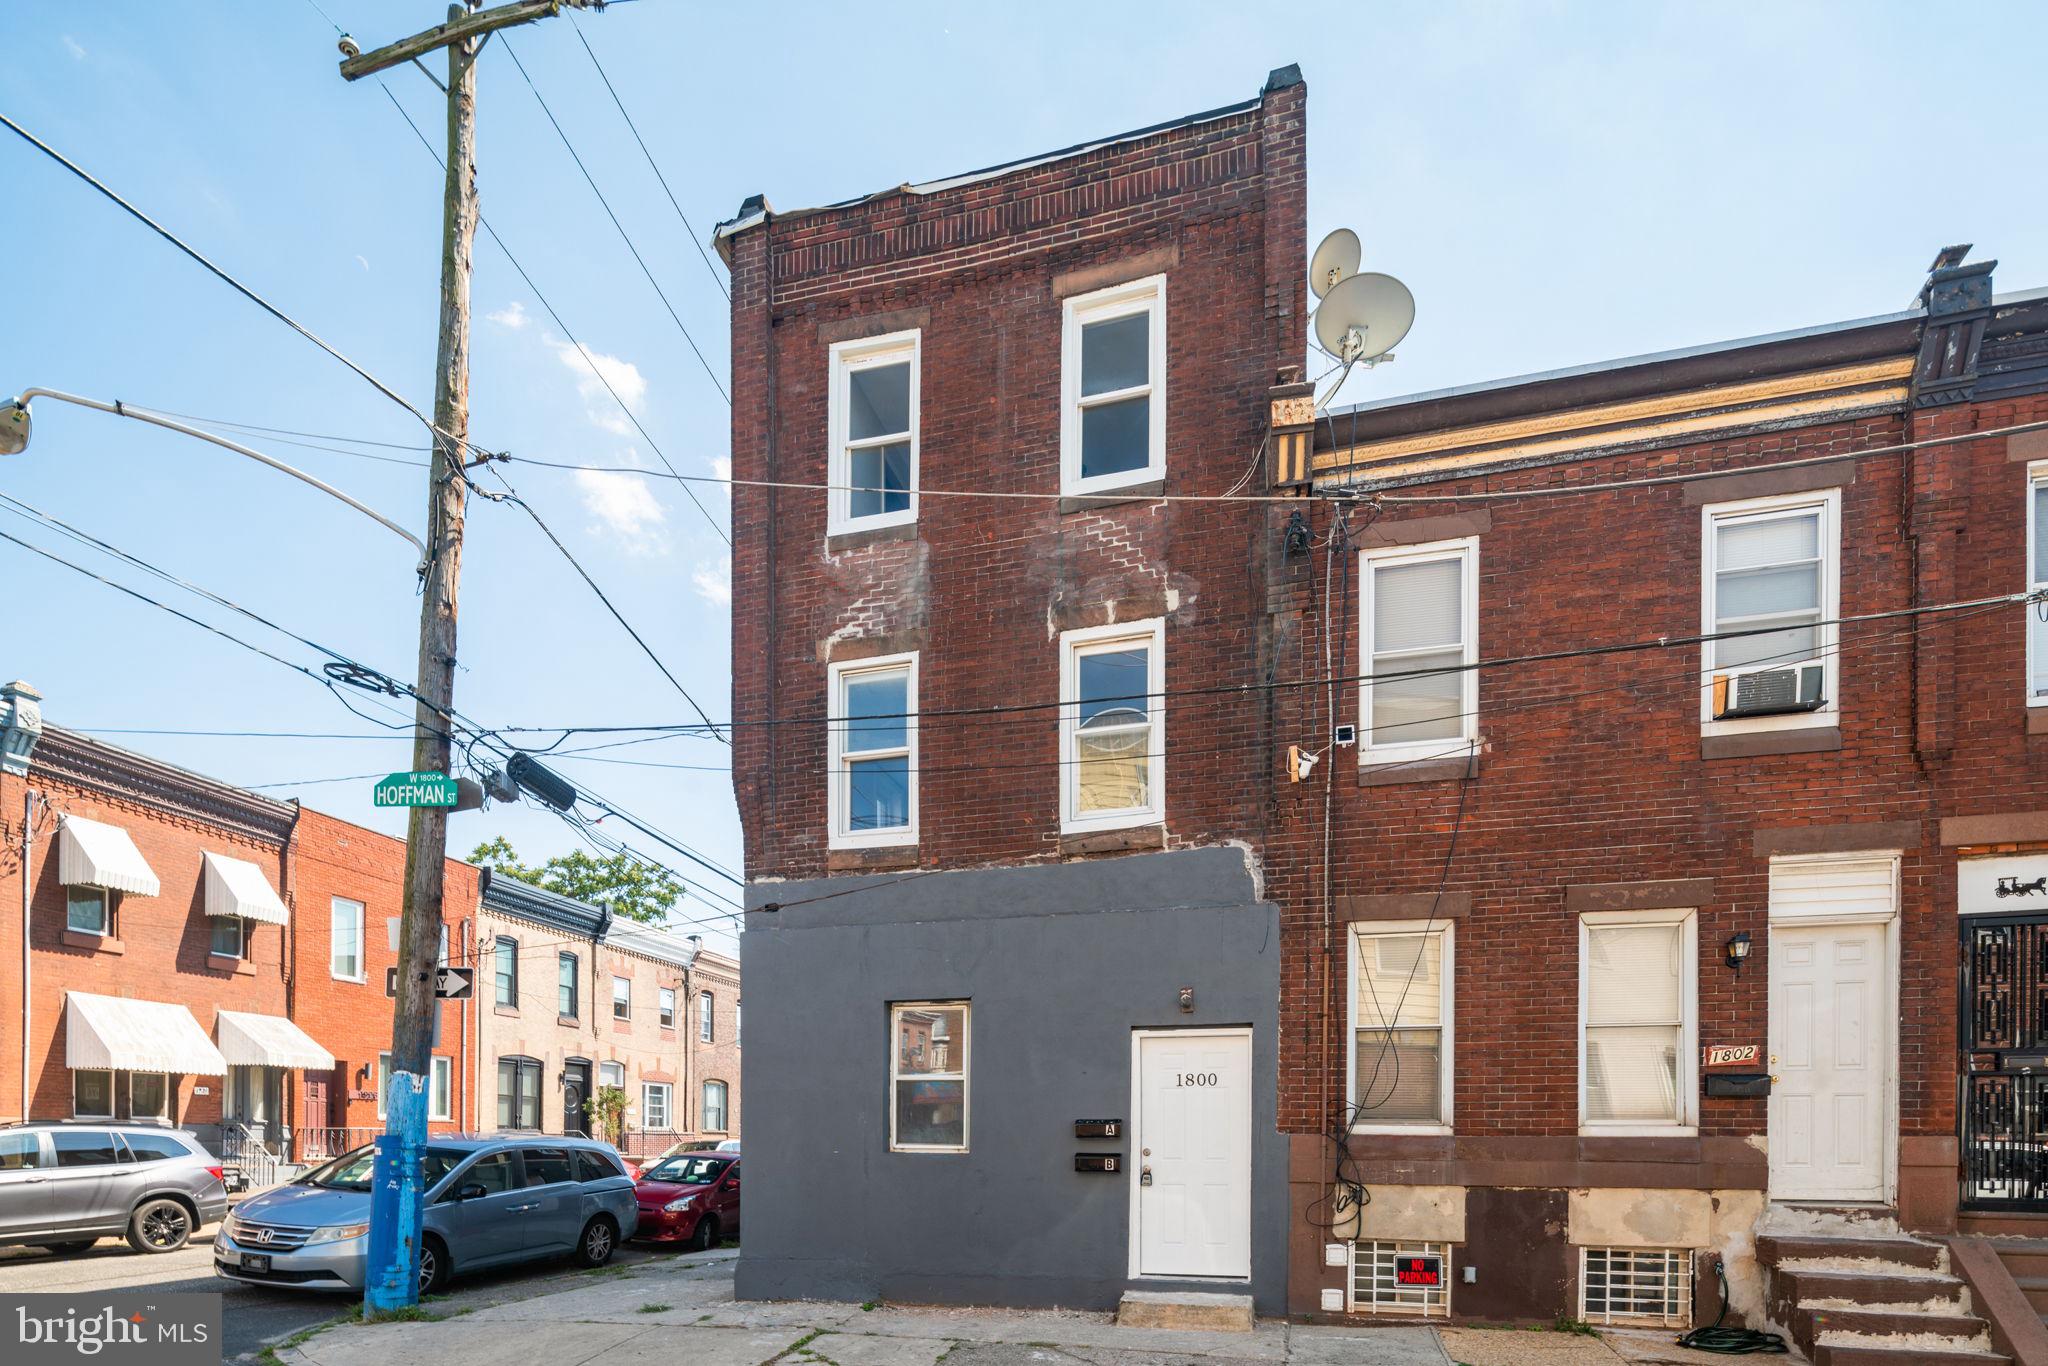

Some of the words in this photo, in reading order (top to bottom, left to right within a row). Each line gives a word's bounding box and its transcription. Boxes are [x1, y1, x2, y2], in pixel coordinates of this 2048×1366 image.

[409, 773, 418, 783] W
[420, 774, 436, 782] 1800
[377, 785, 445, 804] HOFFMAN
[447, 793, 456, 803] ST
[1713, 1047, 1754, 1063] 1802
[1176, 1073, 1218, 1087] 1800
[1106, 1125, 1114, 1135] A
[1106, 1159, 1113, 1169] B
[1411, 1258, 1425, 1271] NO
[1398, 1271, 1438, 1284] PARKING
